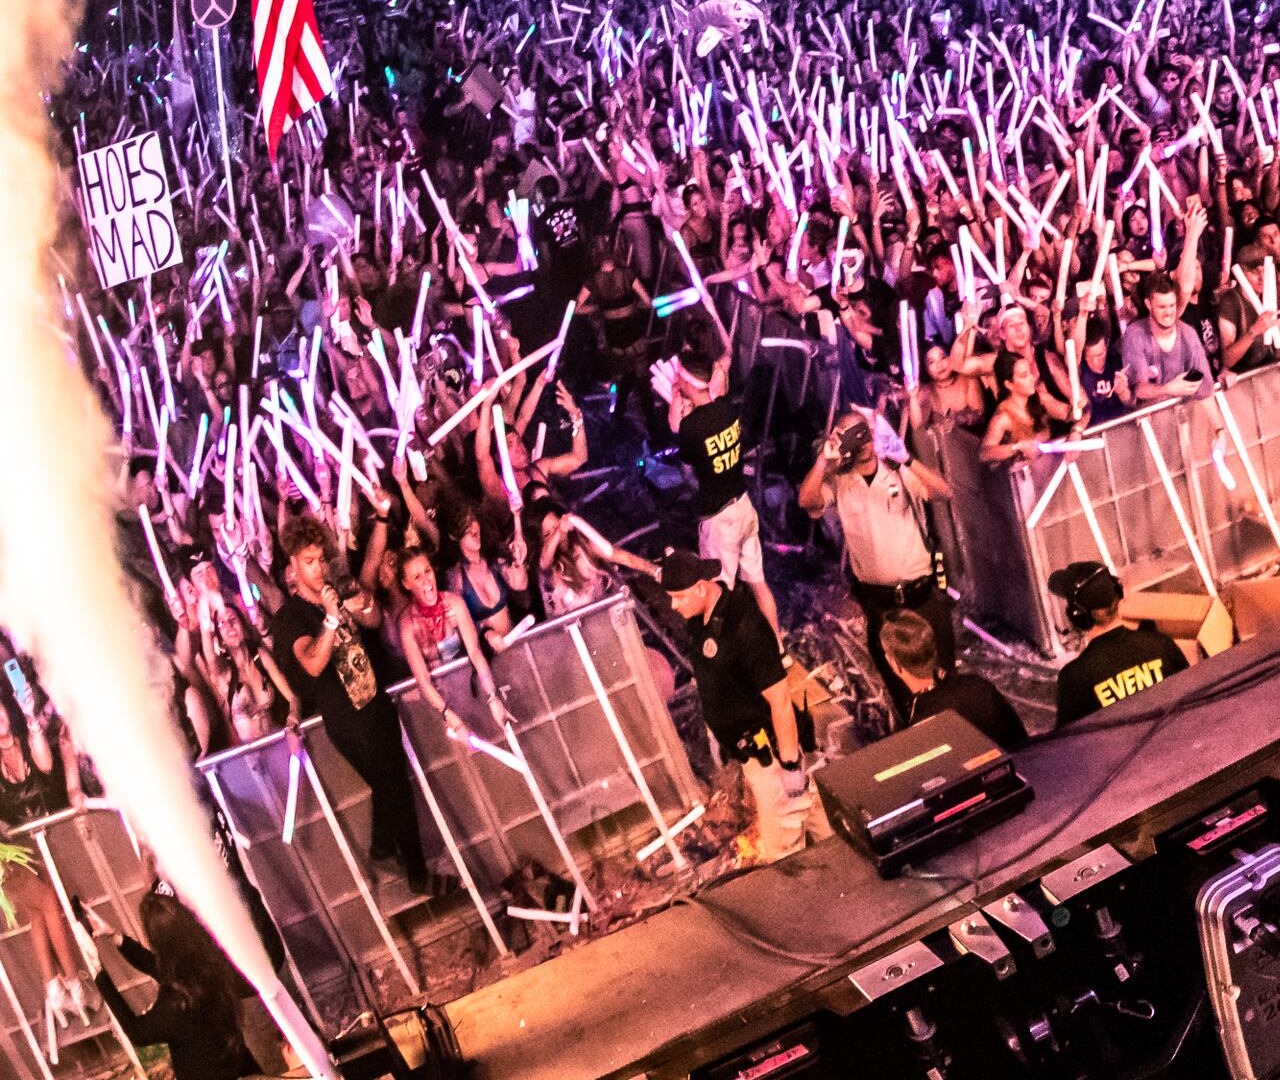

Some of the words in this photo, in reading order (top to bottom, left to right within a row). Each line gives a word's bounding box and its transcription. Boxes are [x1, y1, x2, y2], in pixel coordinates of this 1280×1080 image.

[80, 132, 166, 219] HOES
[91, 209, 175, 288] MAD
[704, 419, 741, 457] EVEN
[1093, 658, 1164, 708] EVENT
